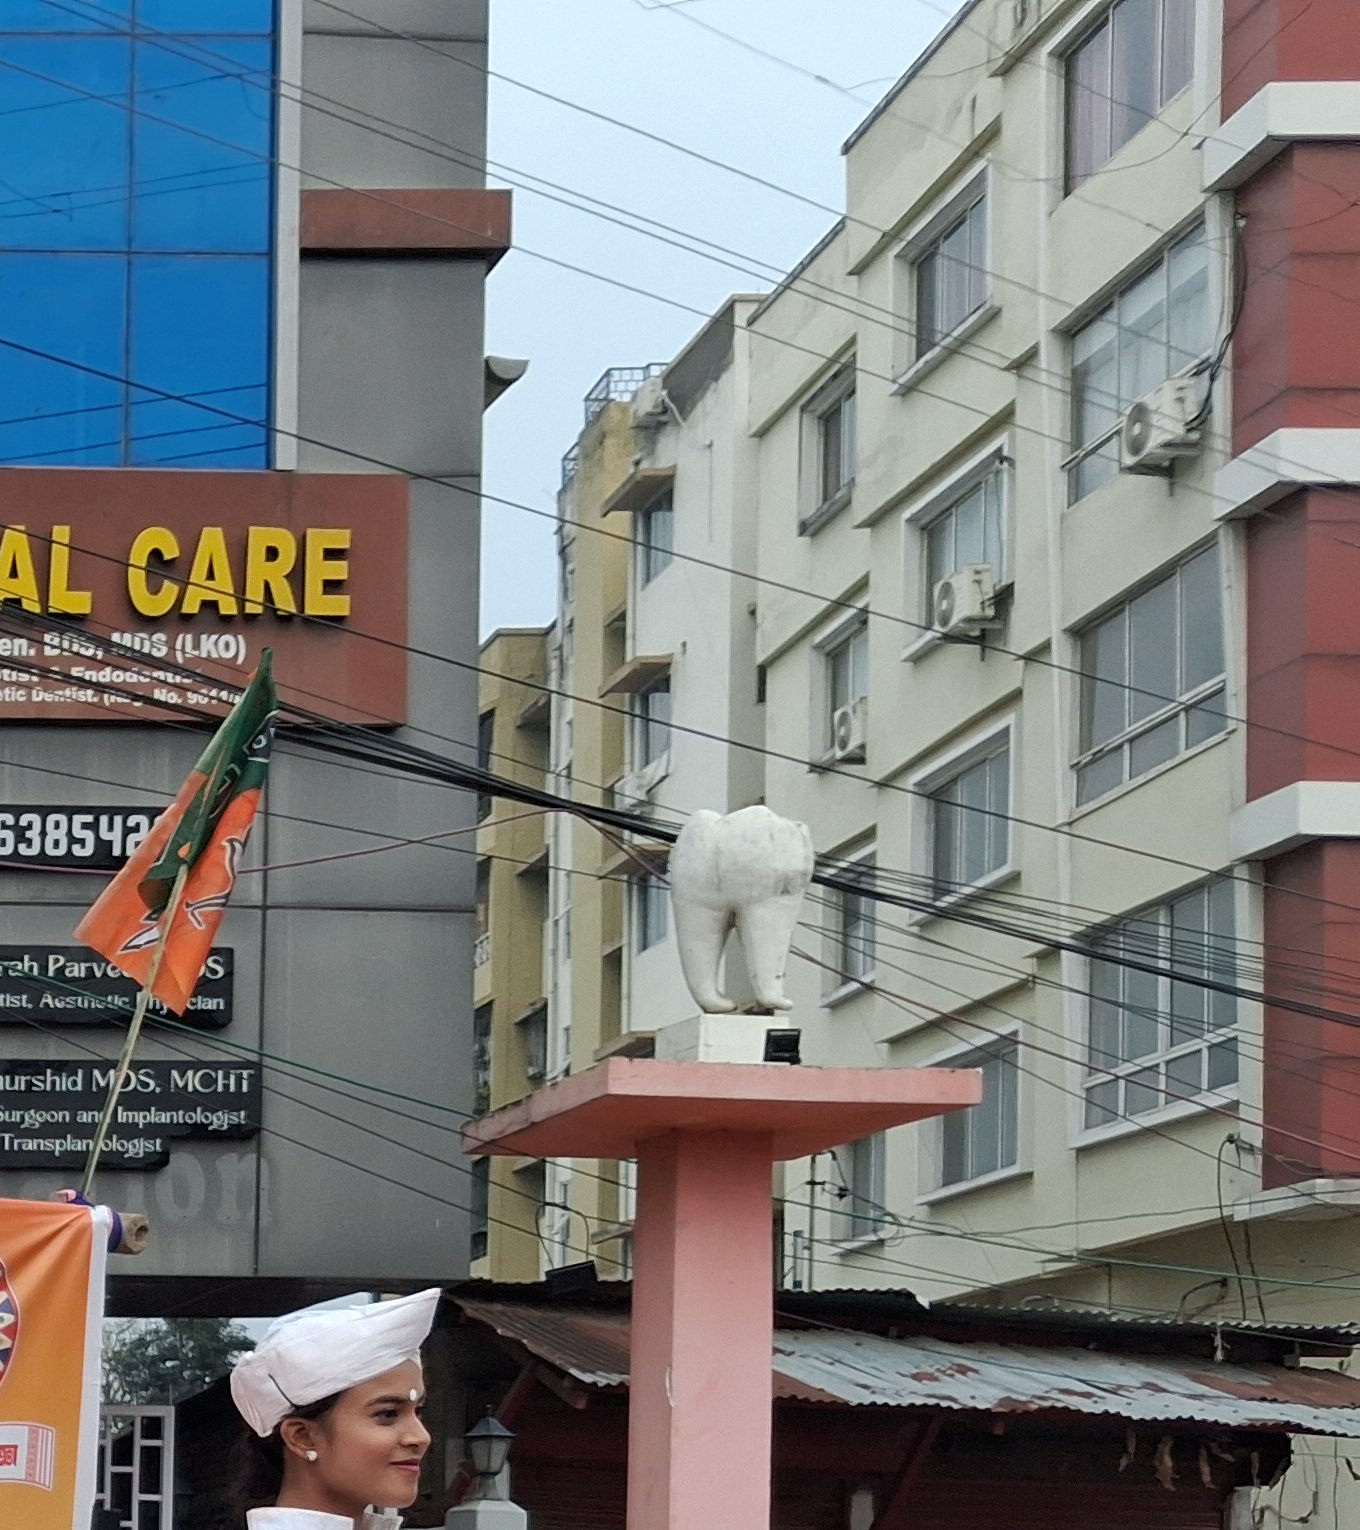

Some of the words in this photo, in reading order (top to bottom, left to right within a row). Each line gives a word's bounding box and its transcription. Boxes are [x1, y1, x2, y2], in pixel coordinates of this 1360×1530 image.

[128, 525, 352, 617] CARE
[174, 633, 247, 665] (LKO)
[47, 955, 130, 978] Parve
[136, 992, 225, 1014] hycian
[169, 1069, 255, 1093] MCHT
[117, 1105, 247, 1130] Implantologist
[0, 1133, 162, 1158] Transplanologist
